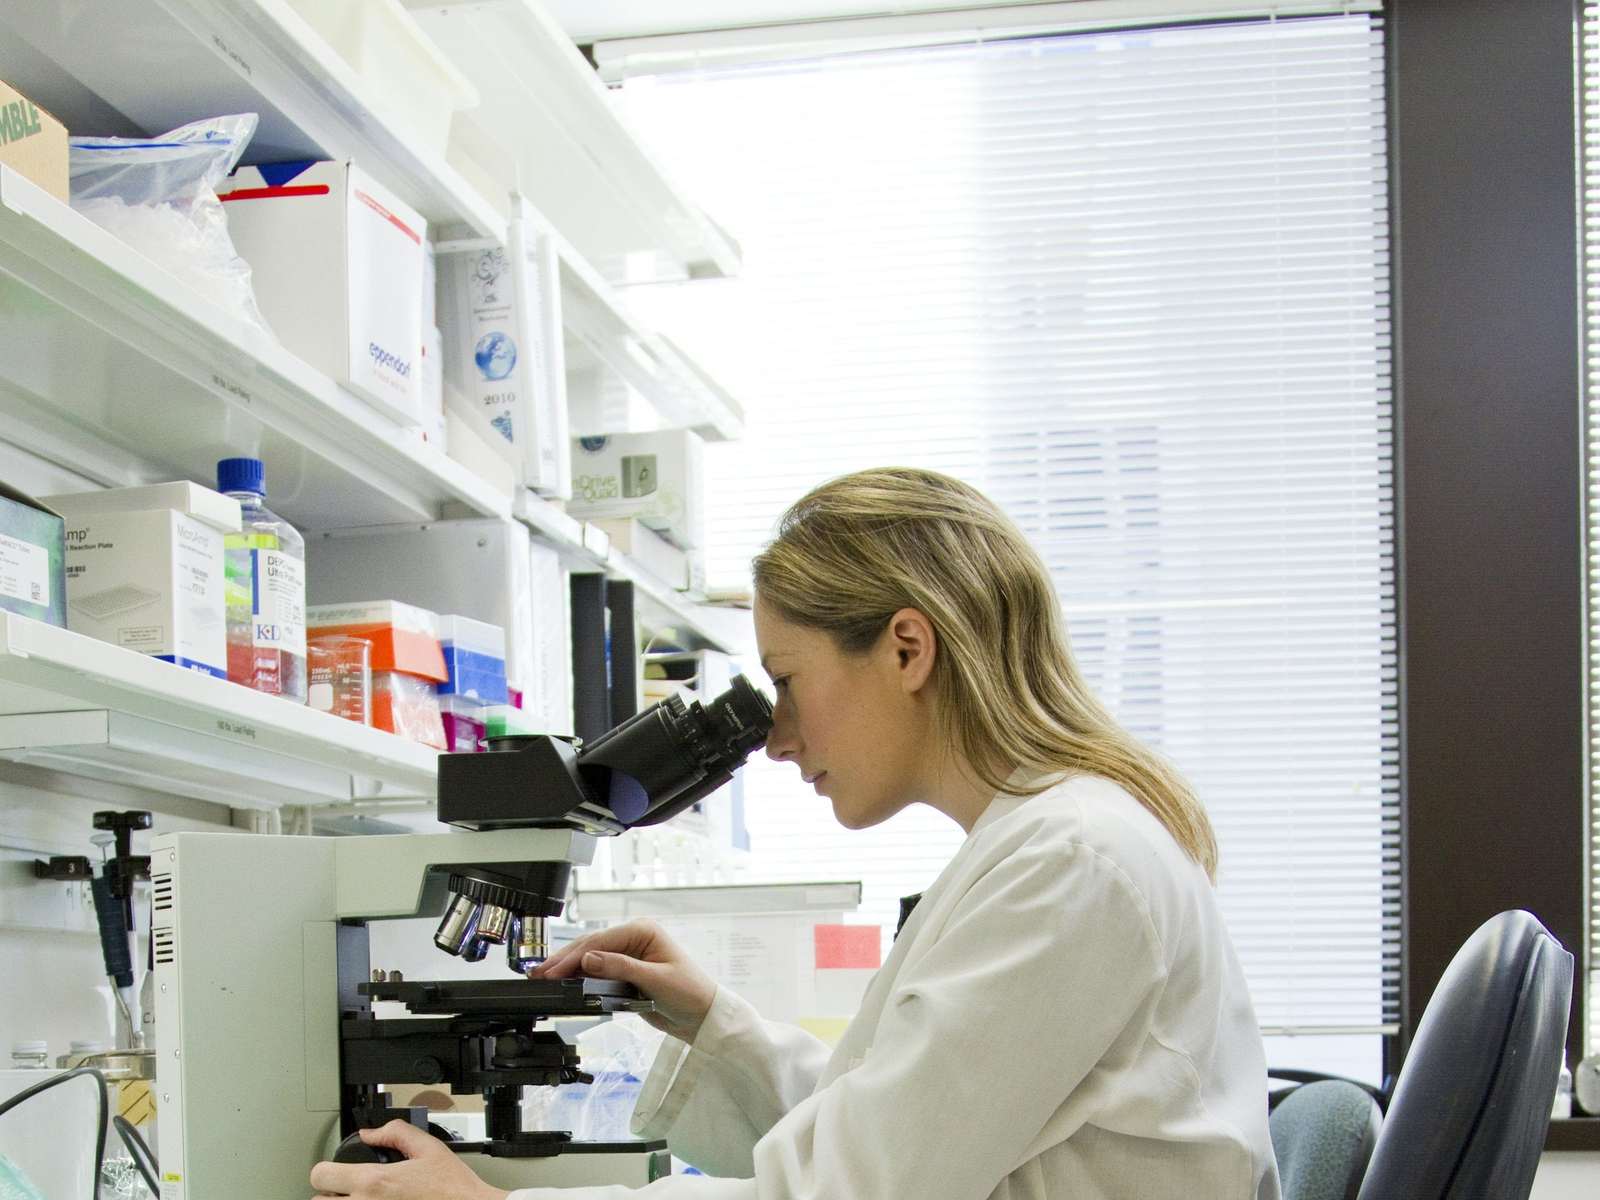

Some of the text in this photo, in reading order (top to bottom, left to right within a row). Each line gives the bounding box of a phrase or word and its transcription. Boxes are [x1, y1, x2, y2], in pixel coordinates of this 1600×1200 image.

[483, 391, 516, 405] 2010
[65, 529, 87, 543] mp
[68, 863, 75, 873] 3
